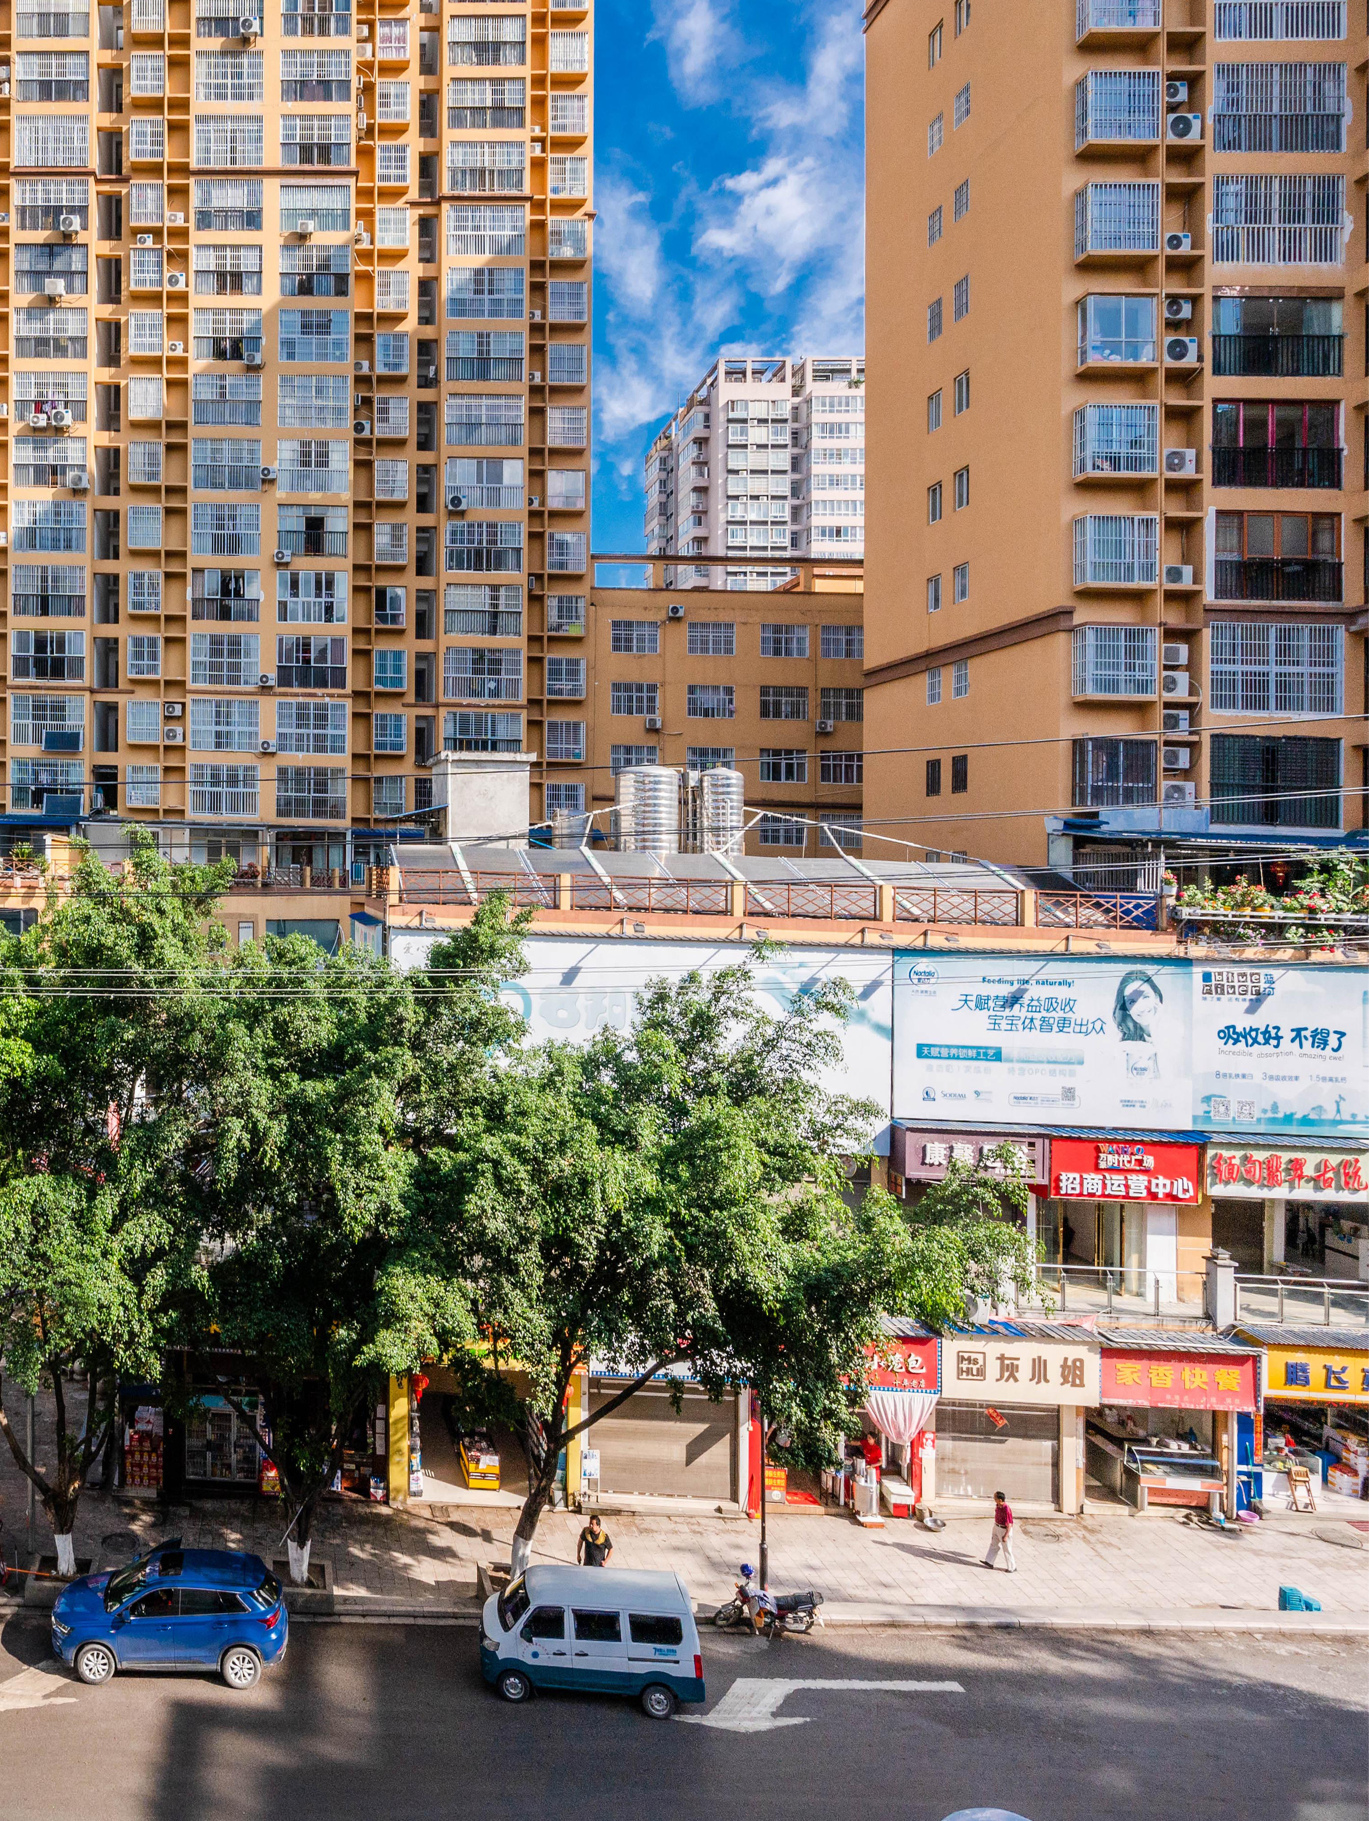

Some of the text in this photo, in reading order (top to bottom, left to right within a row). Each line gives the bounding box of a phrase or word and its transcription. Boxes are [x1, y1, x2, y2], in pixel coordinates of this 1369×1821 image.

[982, 976, 1015, 987] Feeding
[1035, 978, 1075, 988] naturally!
[1214, 971, 1261, 984] blue
[1202, 983, 1262, 996] river
[951, 993, 1078, 1015] 天赋营养益吸收
[986, 1014, 1107, 1037] 宝宝体智更出众
[1217, 1024, 1347, 1053] 吸收好 不得了
[921, 1046, 996, 1061] 天赋营养锁鲜工艺
[1218, 1047, 1254, 1058] Incredible
[1298, 1051, 1327, 1062] amazing
[1097, 1142, 1145, 1155] WANHO
[1212, 1151, 1369, 1191] 缅甸翡翠古玩
[1059, 1172, 1194, 1199] 招商运营中心
[995, 1353, 1086, 1388] 灰小姐
[1115, 1363, 1242, 1392] 家香快餐
